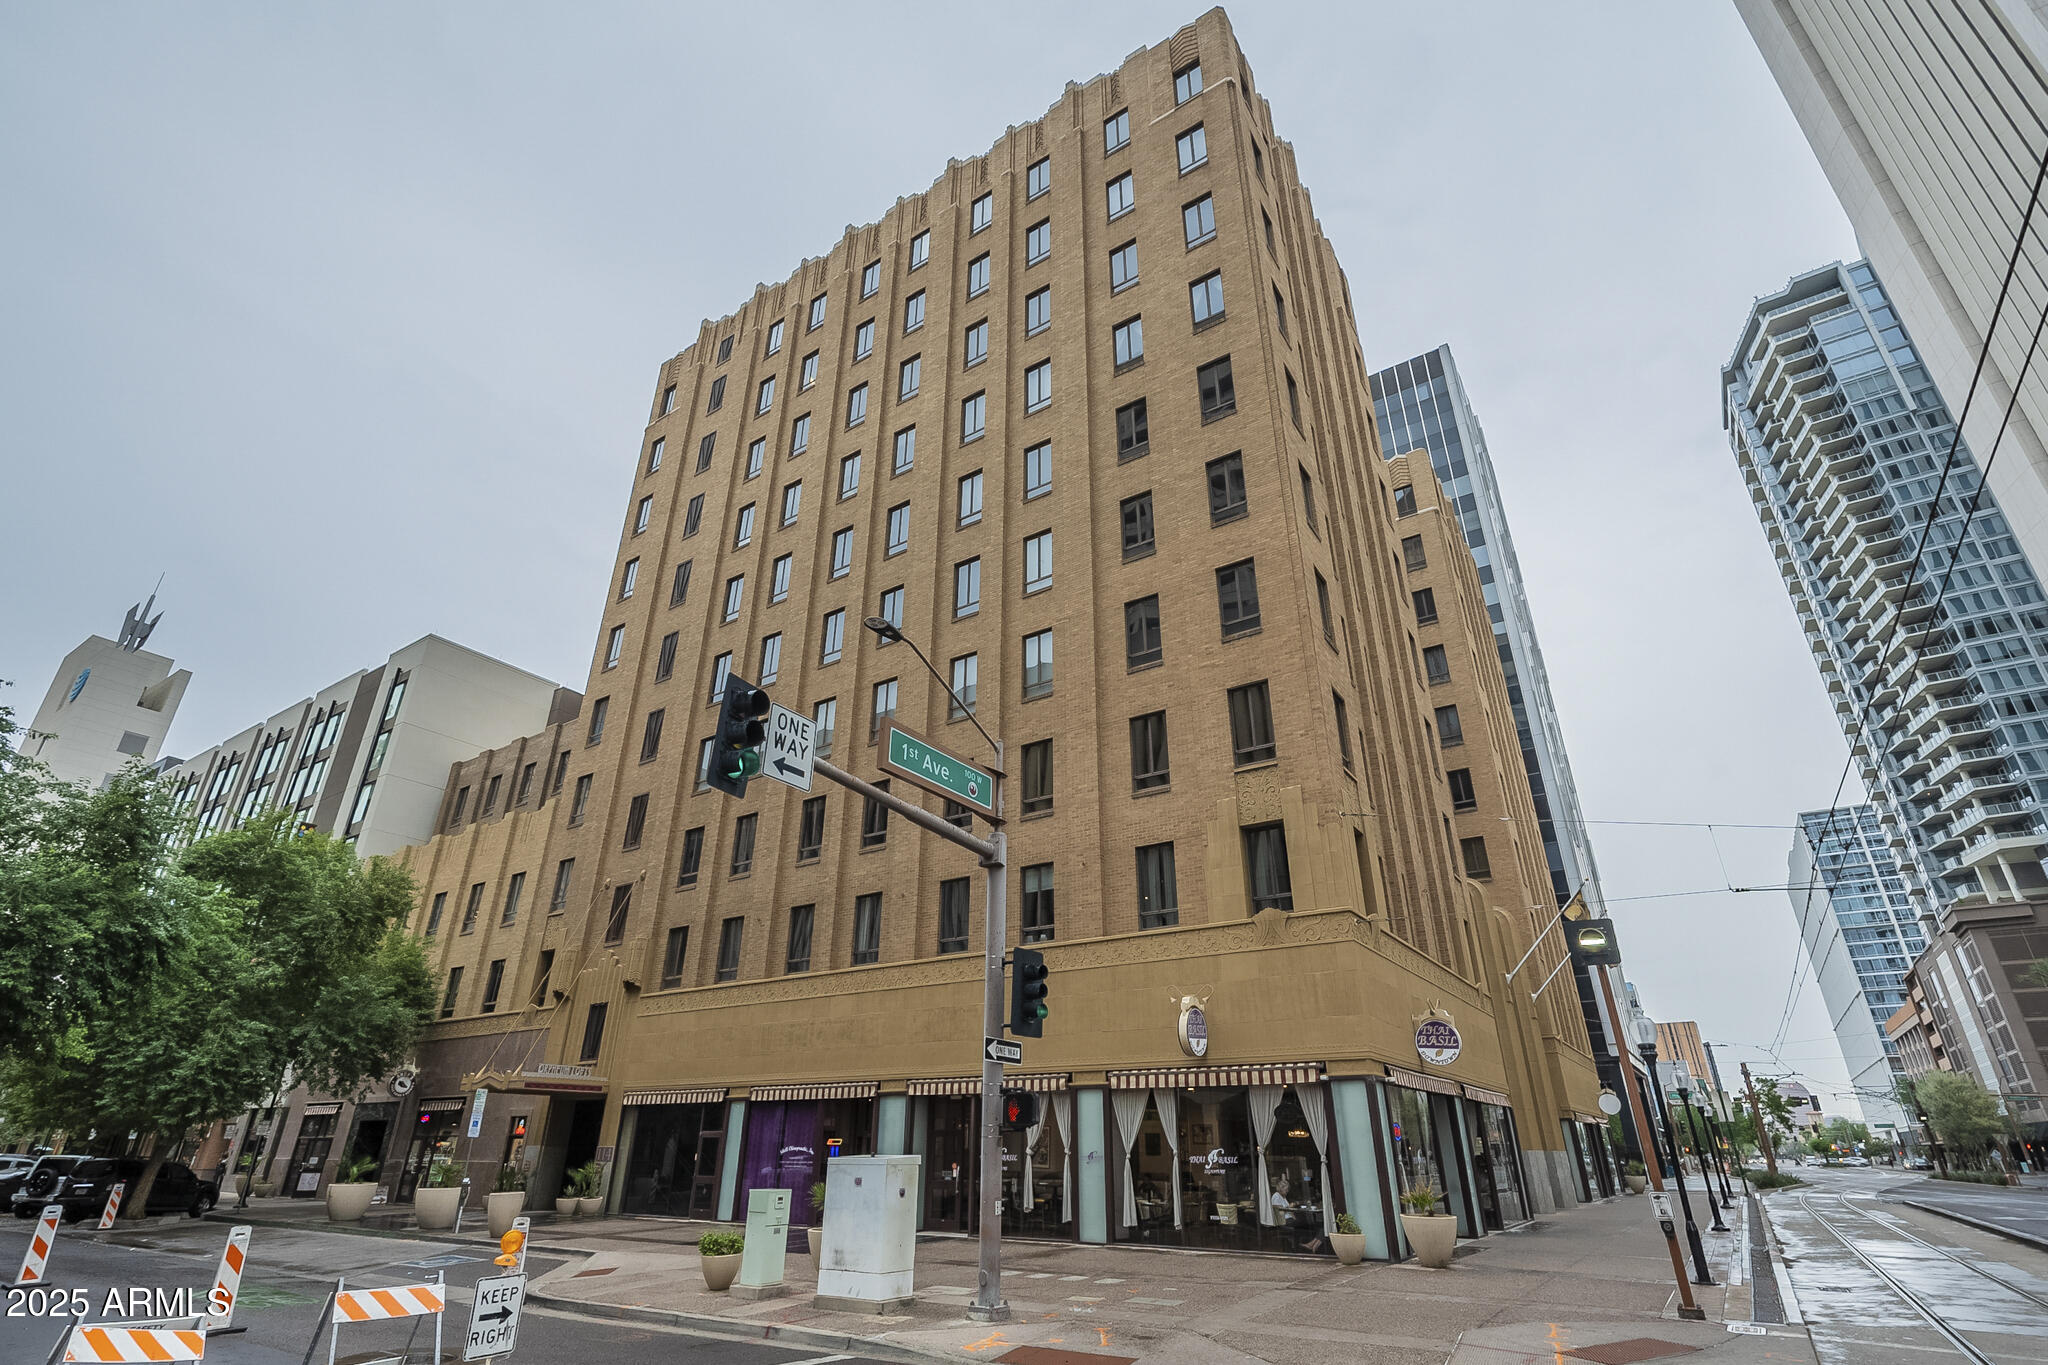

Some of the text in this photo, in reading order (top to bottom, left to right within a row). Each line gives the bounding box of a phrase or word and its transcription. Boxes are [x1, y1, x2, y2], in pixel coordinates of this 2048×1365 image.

[778, 713, 809, 741] ONE
[774, 731, 808, 760] WAY
[902, 743, 953, 783] 1st Ave.
[964, 769, 983, 784] 100 W
[1421, 1025, 1450, 1035] THAI
[1418, 1035, 1458, 1046] BASIL
[995, 1045, 1006, 1056] ONE
[1421, 1050, 1457, 1064] DOWNTOWN
[481, 1287, 519, 1305] KEEP
[470, 1325, 515, 1347] RIGHT
